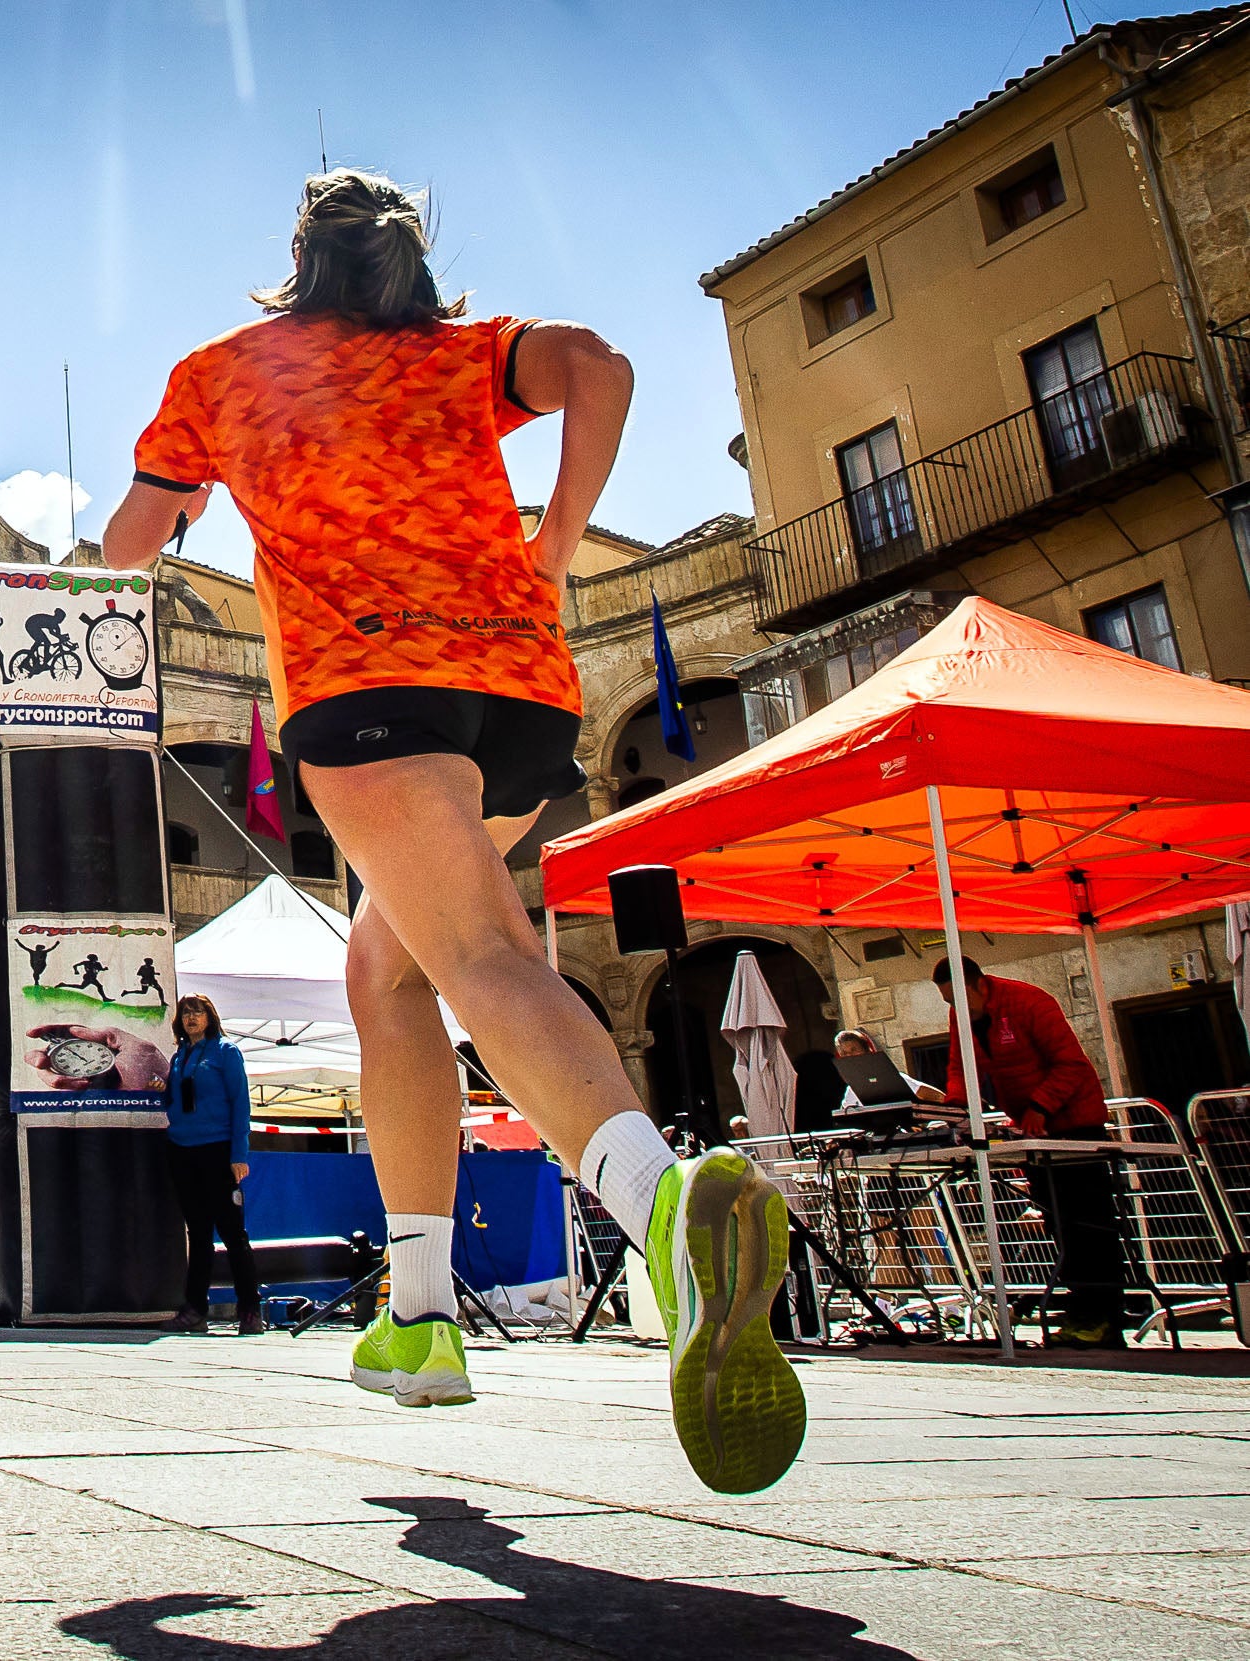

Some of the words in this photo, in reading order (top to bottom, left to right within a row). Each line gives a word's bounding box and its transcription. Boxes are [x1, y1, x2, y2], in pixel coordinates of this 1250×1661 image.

[473, 617, 537, 630] CANTINAS
[14, 688, 99, 704] CRONOMETRAJE
[23, 1099, 161, 1107] www.orycronsport.c
